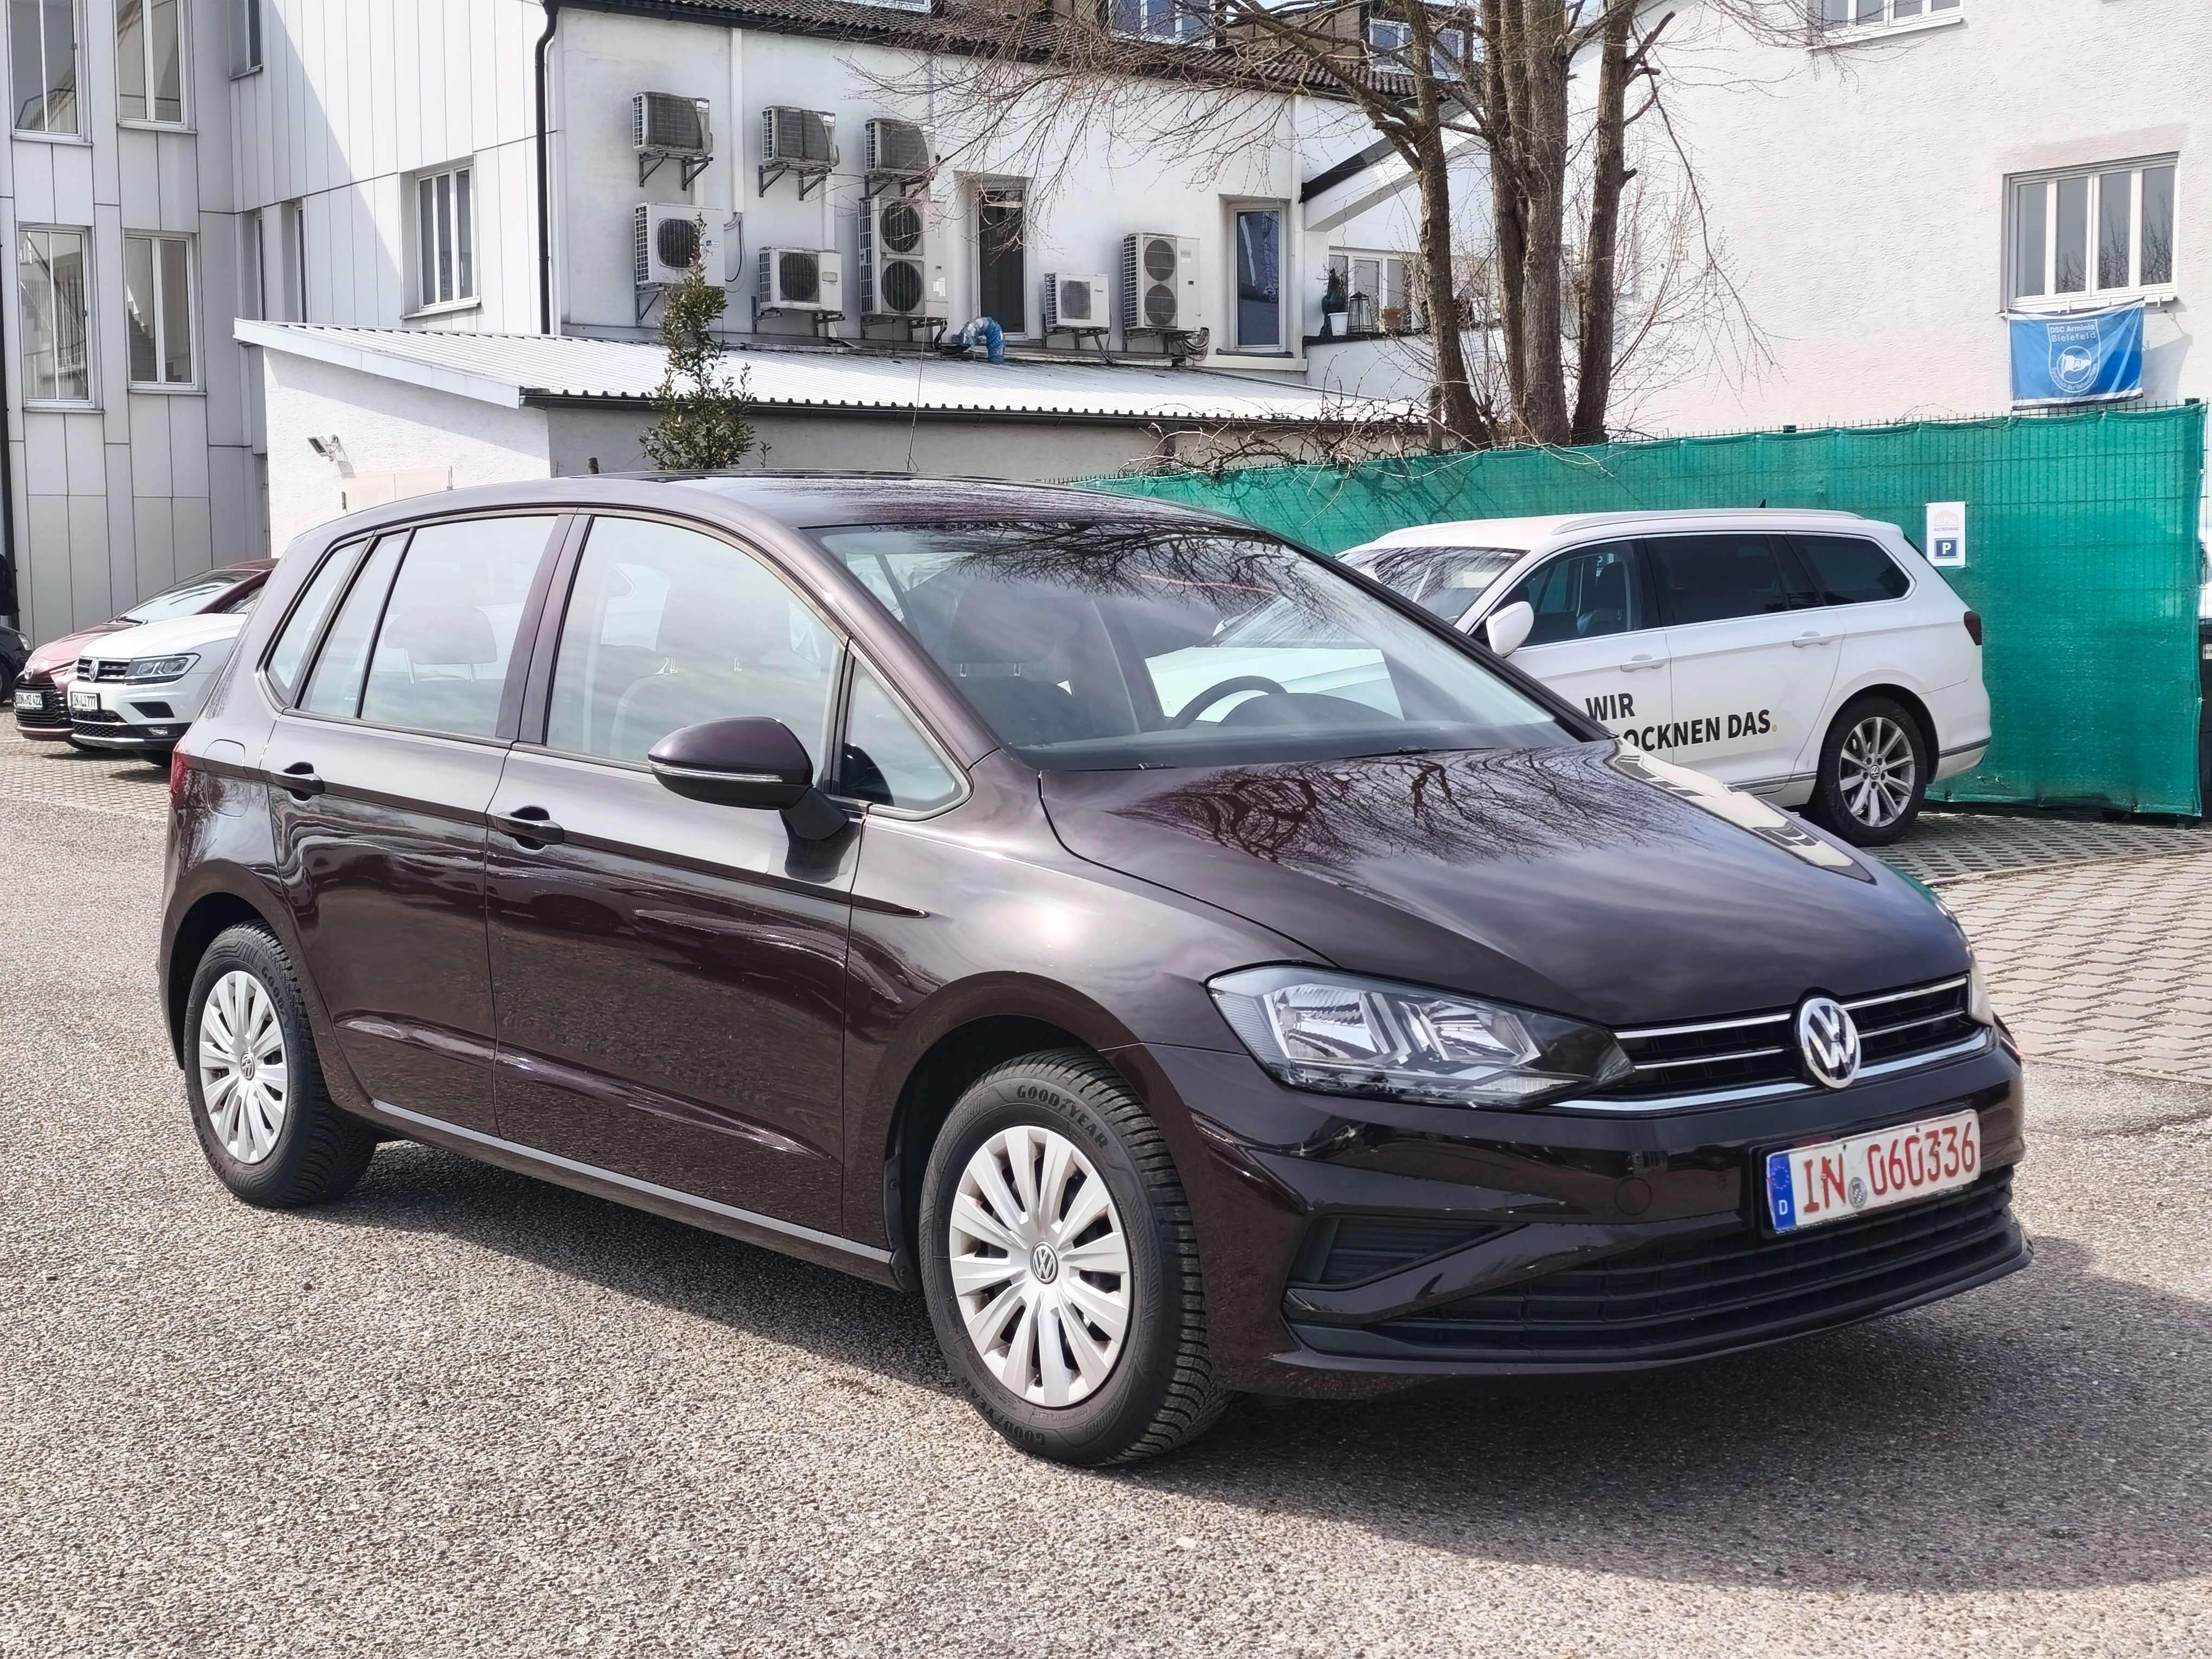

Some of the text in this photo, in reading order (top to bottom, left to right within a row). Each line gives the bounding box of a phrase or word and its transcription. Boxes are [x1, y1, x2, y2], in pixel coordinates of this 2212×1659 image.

[2052, 332, 2096, 342] Bielefeld
[2067, 324, 2095, 332] Arminia
[1942, 542, 1952, 555] P
[87, 696, 95, 708] 777
[1585, 693, 1636, 721] WIR
[1623, 709, 1778, 751] OCKNEN DAS.
[1017, 1085, 1109, 1149] GOODYEAR
[1803, 1122, 1975, 1214] IN 060336
[1779, 1199, 1788, 1215] D
[961, 1375, 1046, 1446] GOODYEAR
